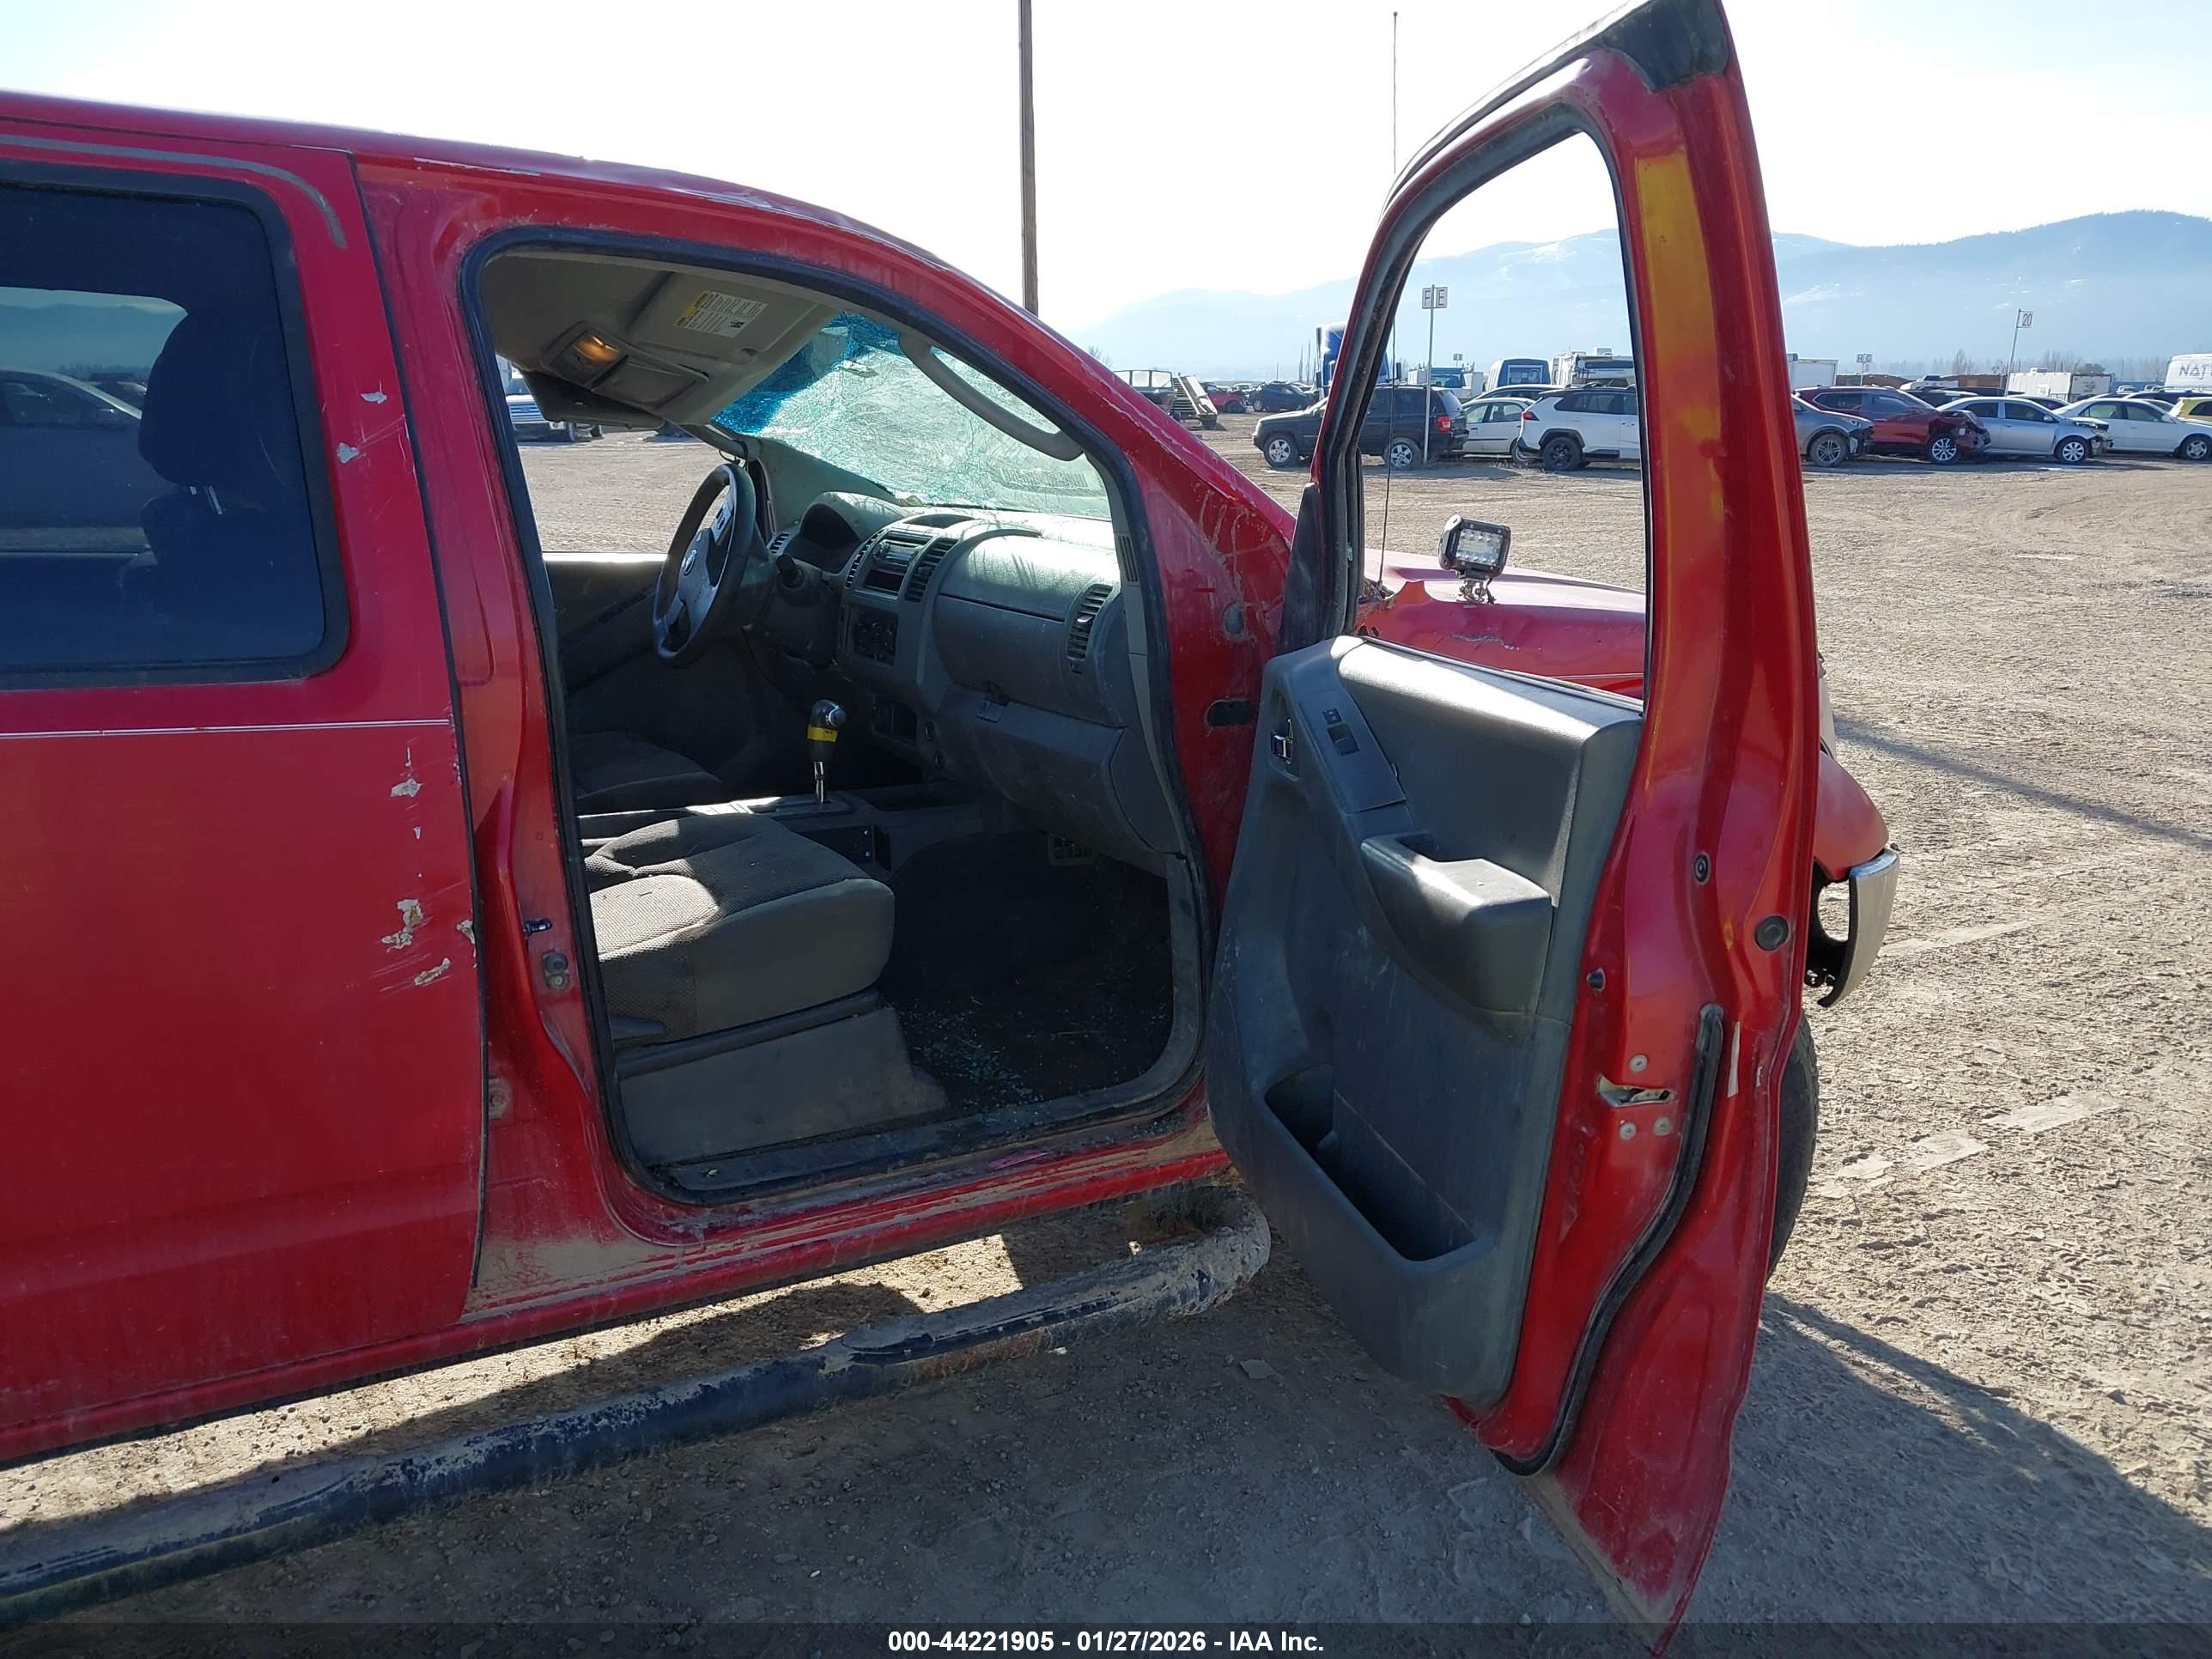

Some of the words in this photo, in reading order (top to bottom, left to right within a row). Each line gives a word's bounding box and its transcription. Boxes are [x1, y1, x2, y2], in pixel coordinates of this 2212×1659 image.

[1425, 289, 1431, 307] F
[1438, 289, 1445, 306] E
[2022, 313, 2033, 326] 20
